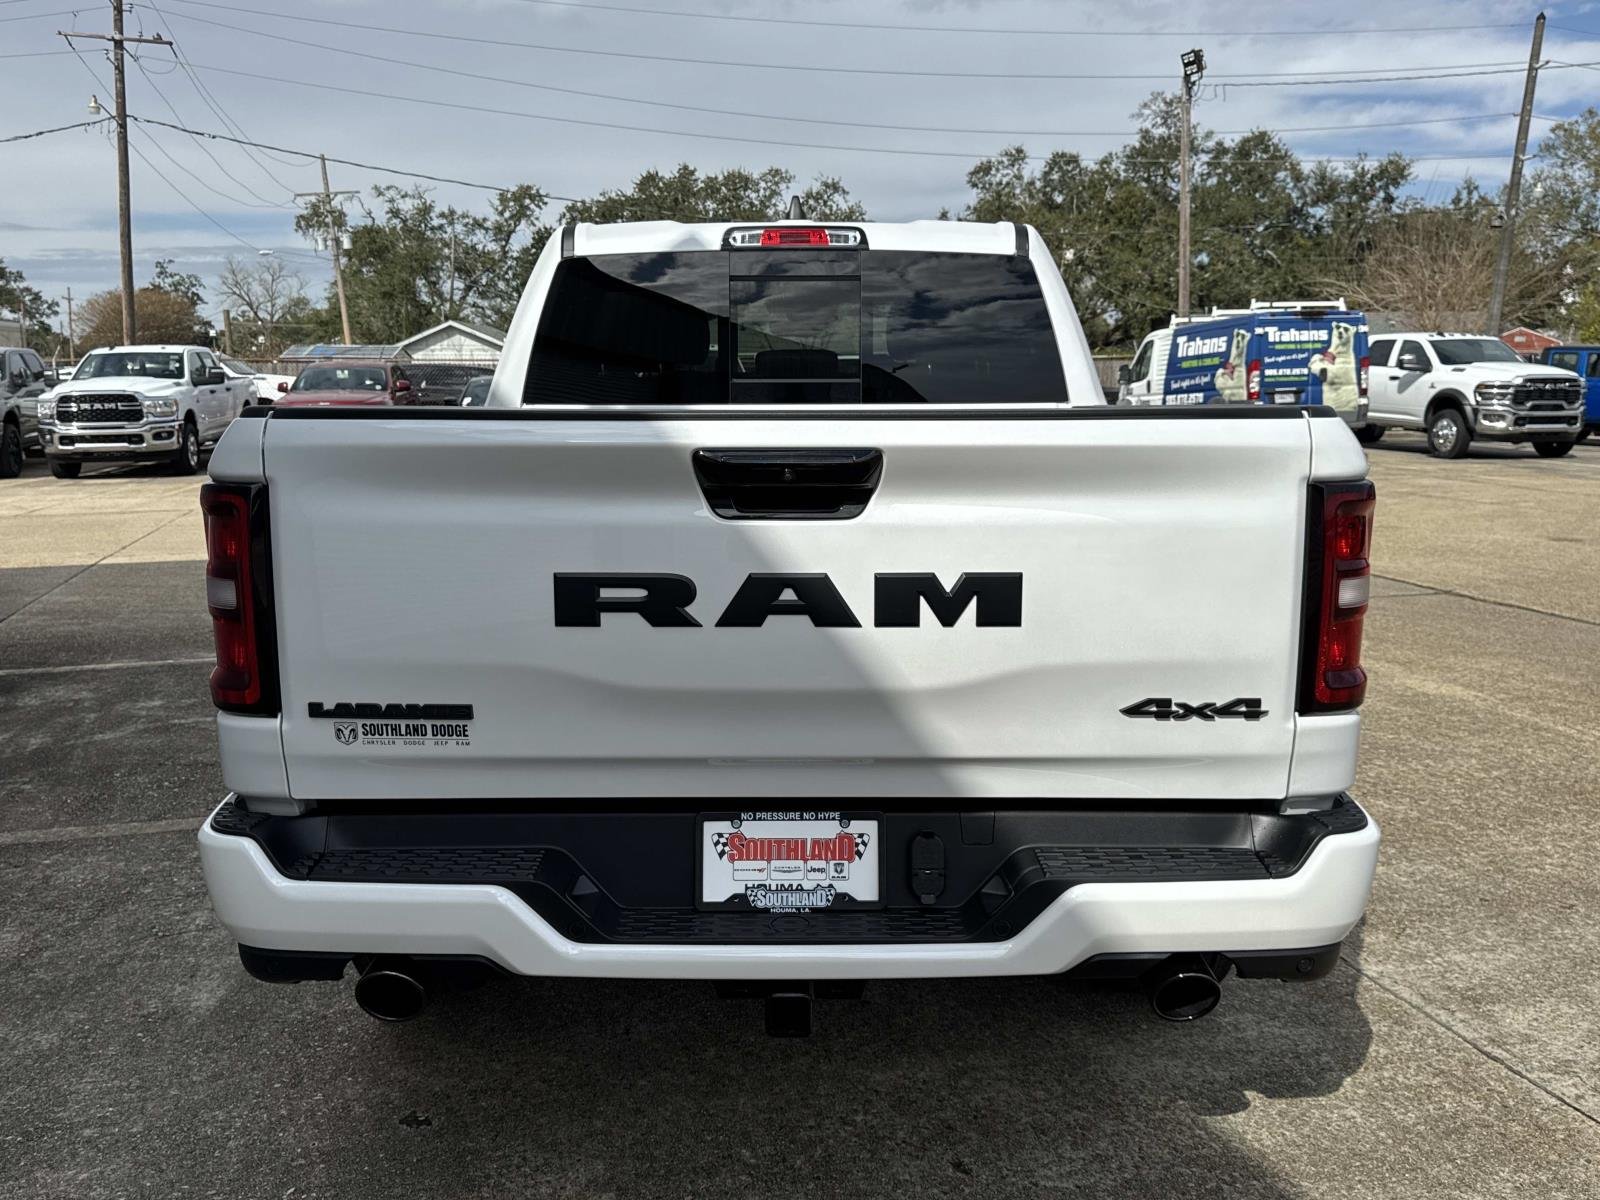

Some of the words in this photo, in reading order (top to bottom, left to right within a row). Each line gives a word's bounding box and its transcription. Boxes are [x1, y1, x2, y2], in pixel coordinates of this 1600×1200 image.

[1265, 326, 1328, 342] Trahans
[1177, 335, 1228, 358] Trahans
[553, 572, 1023, 628] RAM
[1118, 697, 1270, 722] 4x4
[361, 723, 428, 737] SOUTHLAND
[431, 723, 469, 738] DODGE
[741, 812, 754, 820] NO
[756, 812, 801, 820] PRESSURE
[803, 812, 816, 820] NO
[818, 812, 841, 820] HYPE
[727, 832, 856, 863] SOUTHLAND
[807, 866, 826, 876] Jeep
[756, 890, 827, 907] SOUTHLAND
